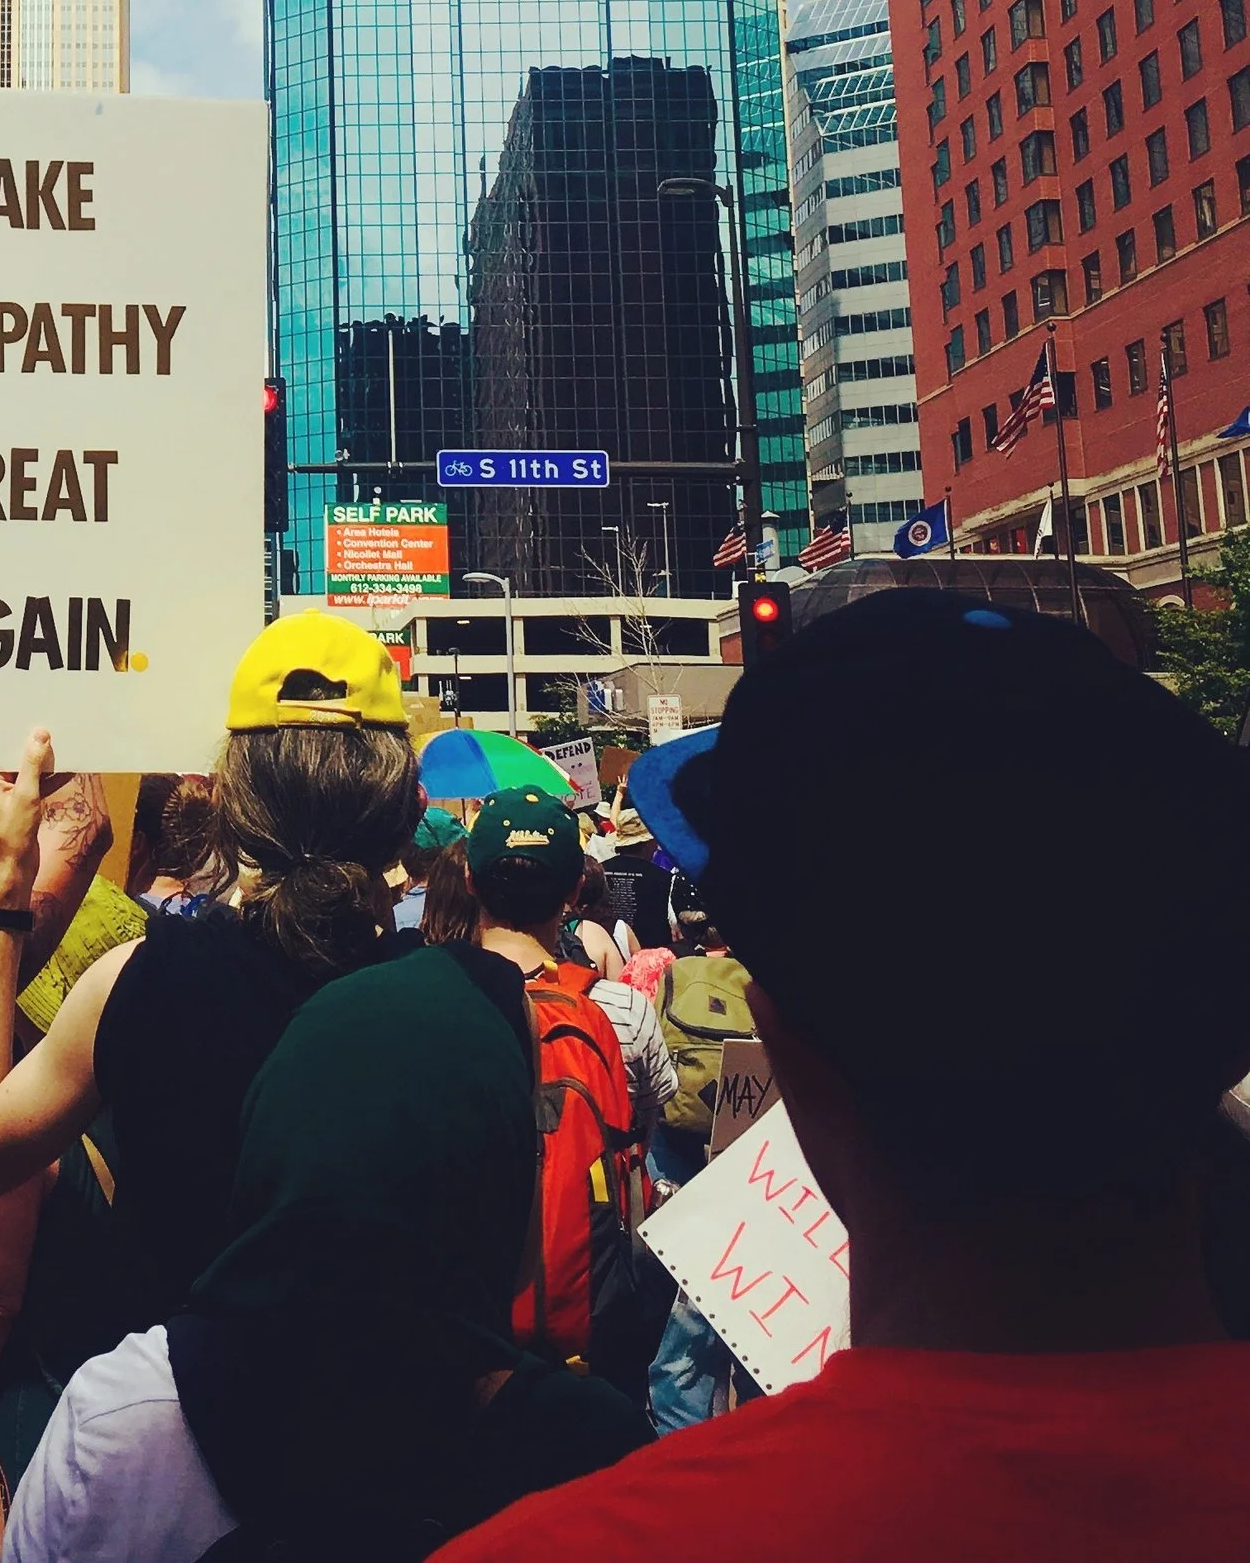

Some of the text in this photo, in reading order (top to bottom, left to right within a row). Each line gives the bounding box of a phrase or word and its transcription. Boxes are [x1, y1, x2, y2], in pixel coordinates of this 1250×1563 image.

[479, 458, 602, 479] S 11th St
[333, 506, 438, 523] SELF PARK
[343, 527, 399, 537] Area Hotels
[343, 538, 434, 548] Convention Center
[343, 549, 403, 559] Nicollet Mall
[343, 561, 413, 570] Orchestra Hall
[331, 574, 442, 582] MONTHLY PARKING AVAILABLE
[544, 741, 592, 762] DEFEND
[715, 1073, 774, 1120] MAY
[748, 1140, 849, 1279] WILL
